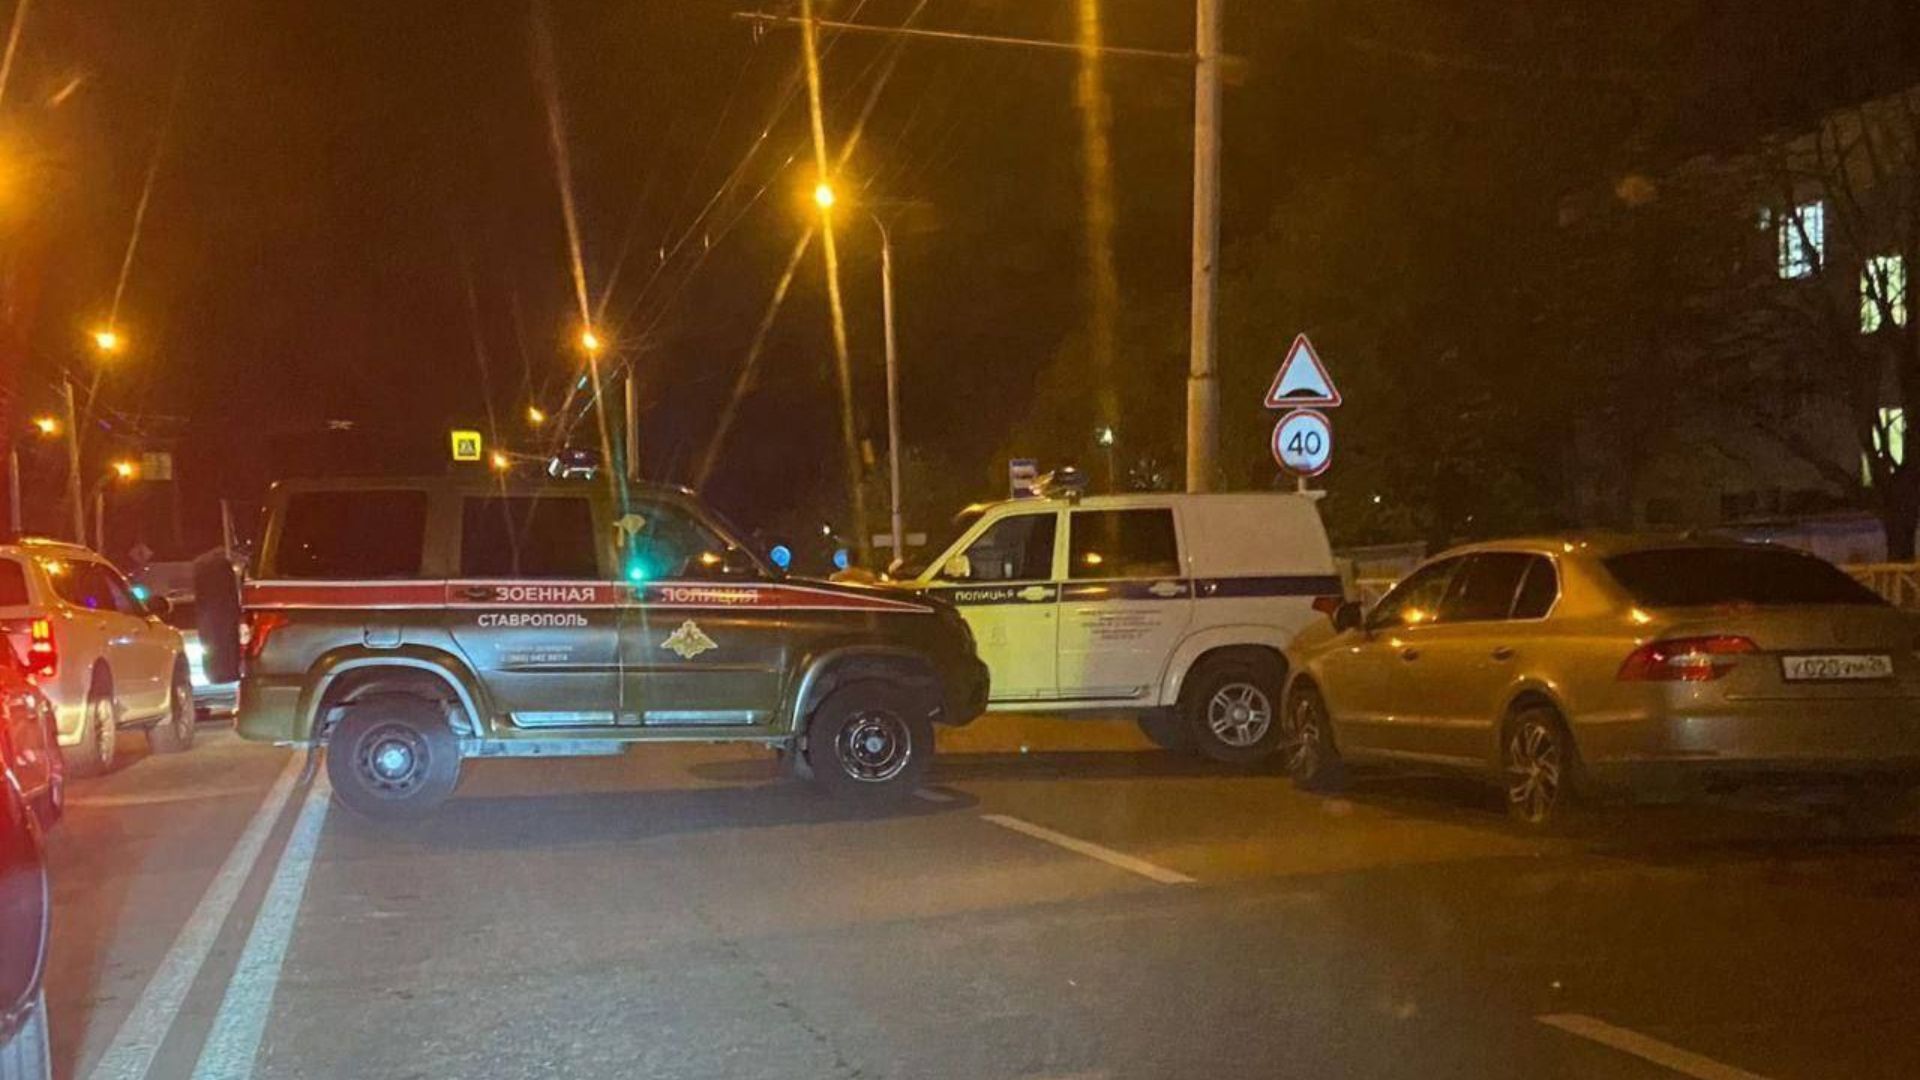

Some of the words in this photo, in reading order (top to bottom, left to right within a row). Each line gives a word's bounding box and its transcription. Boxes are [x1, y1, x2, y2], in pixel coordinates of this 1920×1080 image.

[1287, 430, 1322, 456] 40
[661, 587, 759, 604] ПОЛИЦИЯ
[477, 613, 589, 628] СТАВРОПОЛЬ
